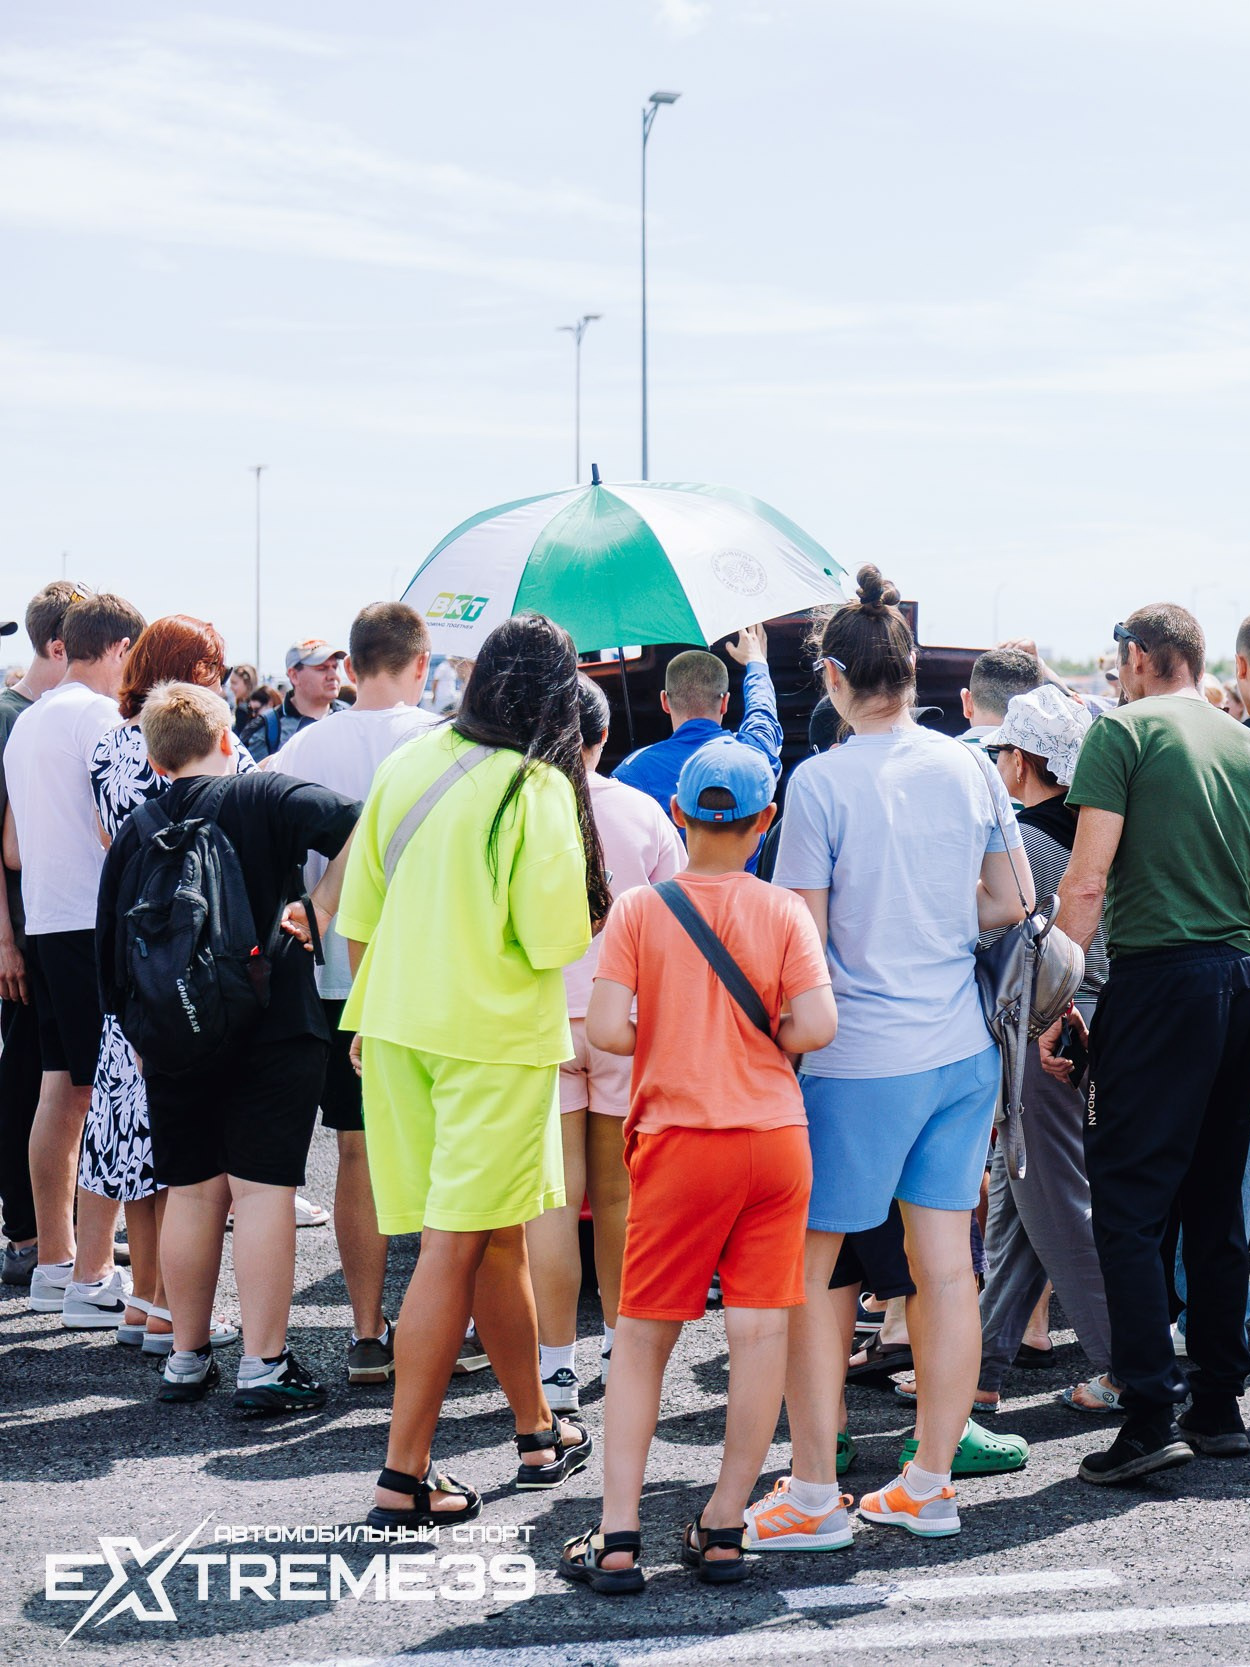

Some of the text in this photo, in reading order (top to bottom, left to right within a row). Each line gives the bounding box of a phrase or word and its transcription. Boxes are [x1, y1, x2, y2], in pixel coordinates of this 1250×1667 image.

[428, 594, 488, 620] BKT
[176, 978, 201, 1033] GOODYEAR
[1088, 1080, 1096, 1126] JORDAN
